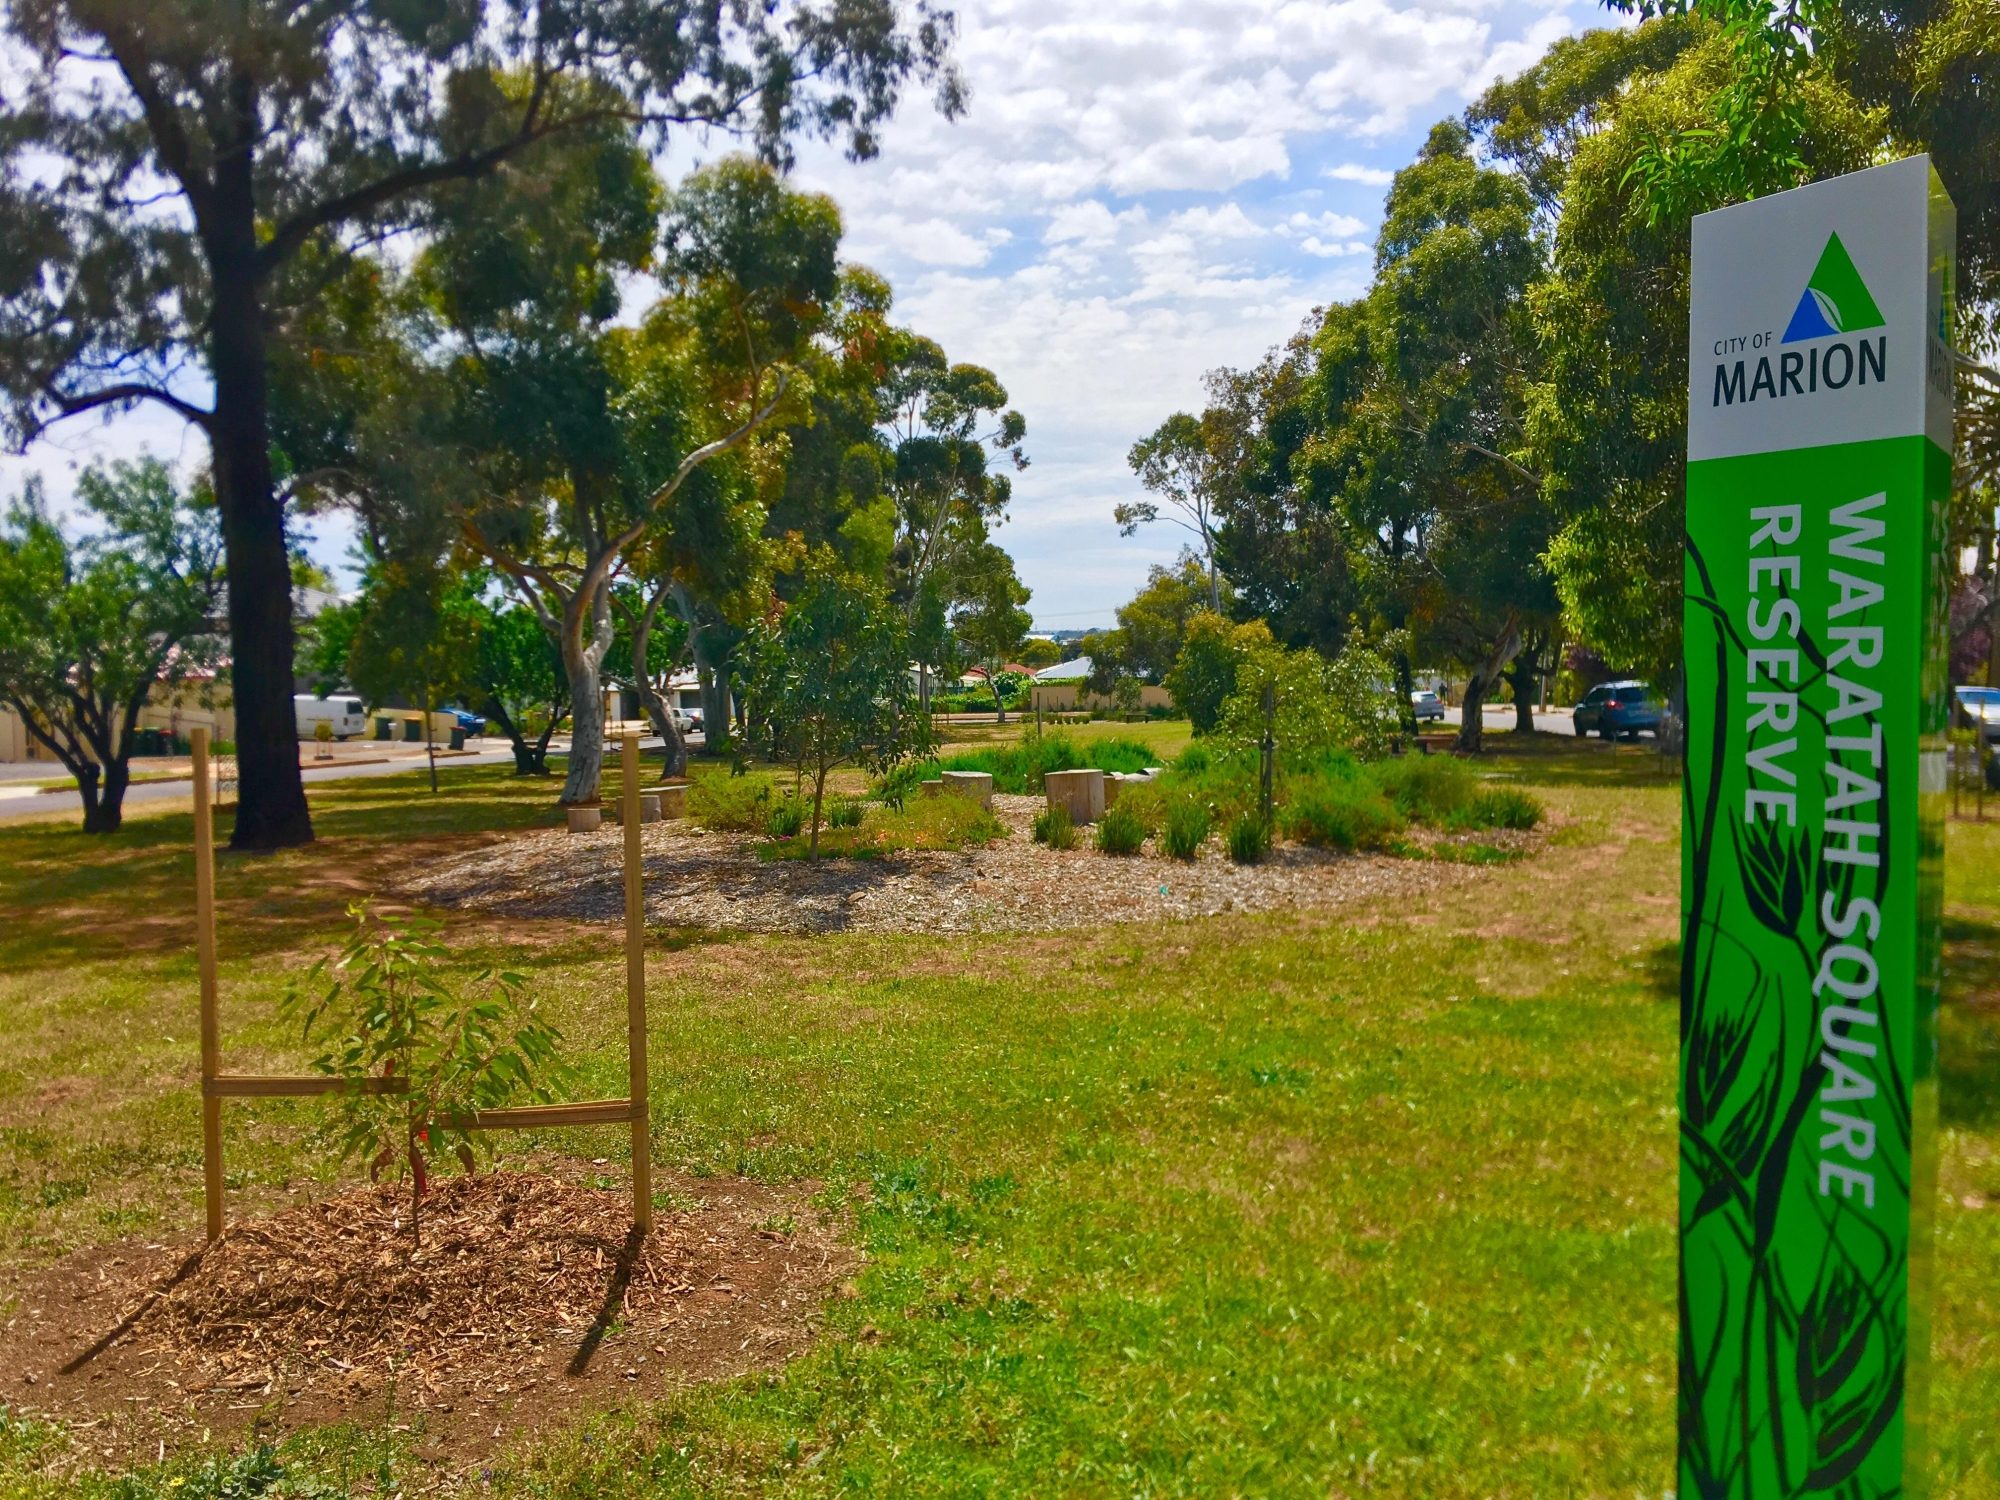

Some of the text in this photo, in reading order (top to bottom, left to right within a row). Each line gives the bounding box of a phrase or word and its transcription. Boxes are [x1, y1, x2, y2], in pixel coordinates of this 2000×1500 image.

[1713, 336, 1886, 407] MARION
[1714, 331, 1773, 356] CITY OF
[1745, 504, 1802, 827] RESERVE
[1812, 491, 1887, 1208] WARATAH SQUARE
